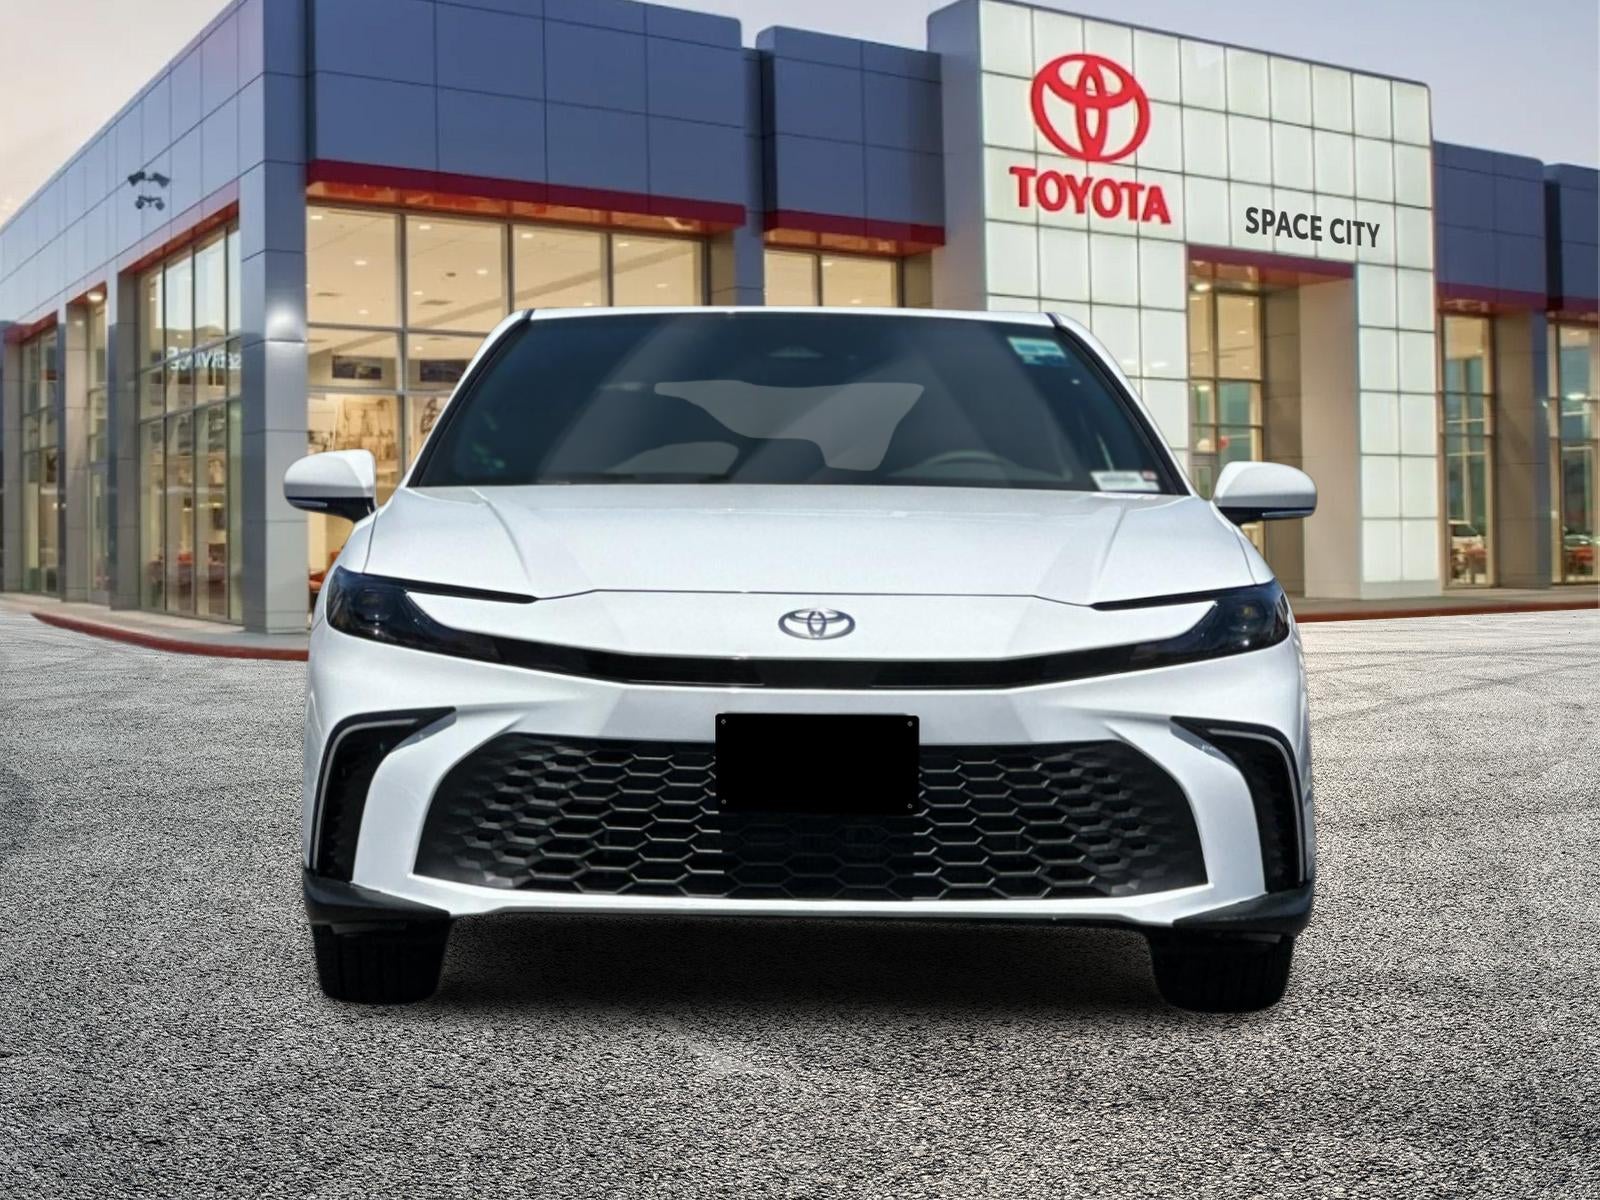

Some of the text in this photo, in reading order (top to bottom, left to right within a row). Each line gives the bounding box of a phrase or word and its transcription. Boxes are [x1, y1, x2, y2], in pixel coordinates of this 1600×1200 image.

[1009, 166, 1171, 224] TOYOTA
[1245, 207, 1380, 248] SPACE CITY
